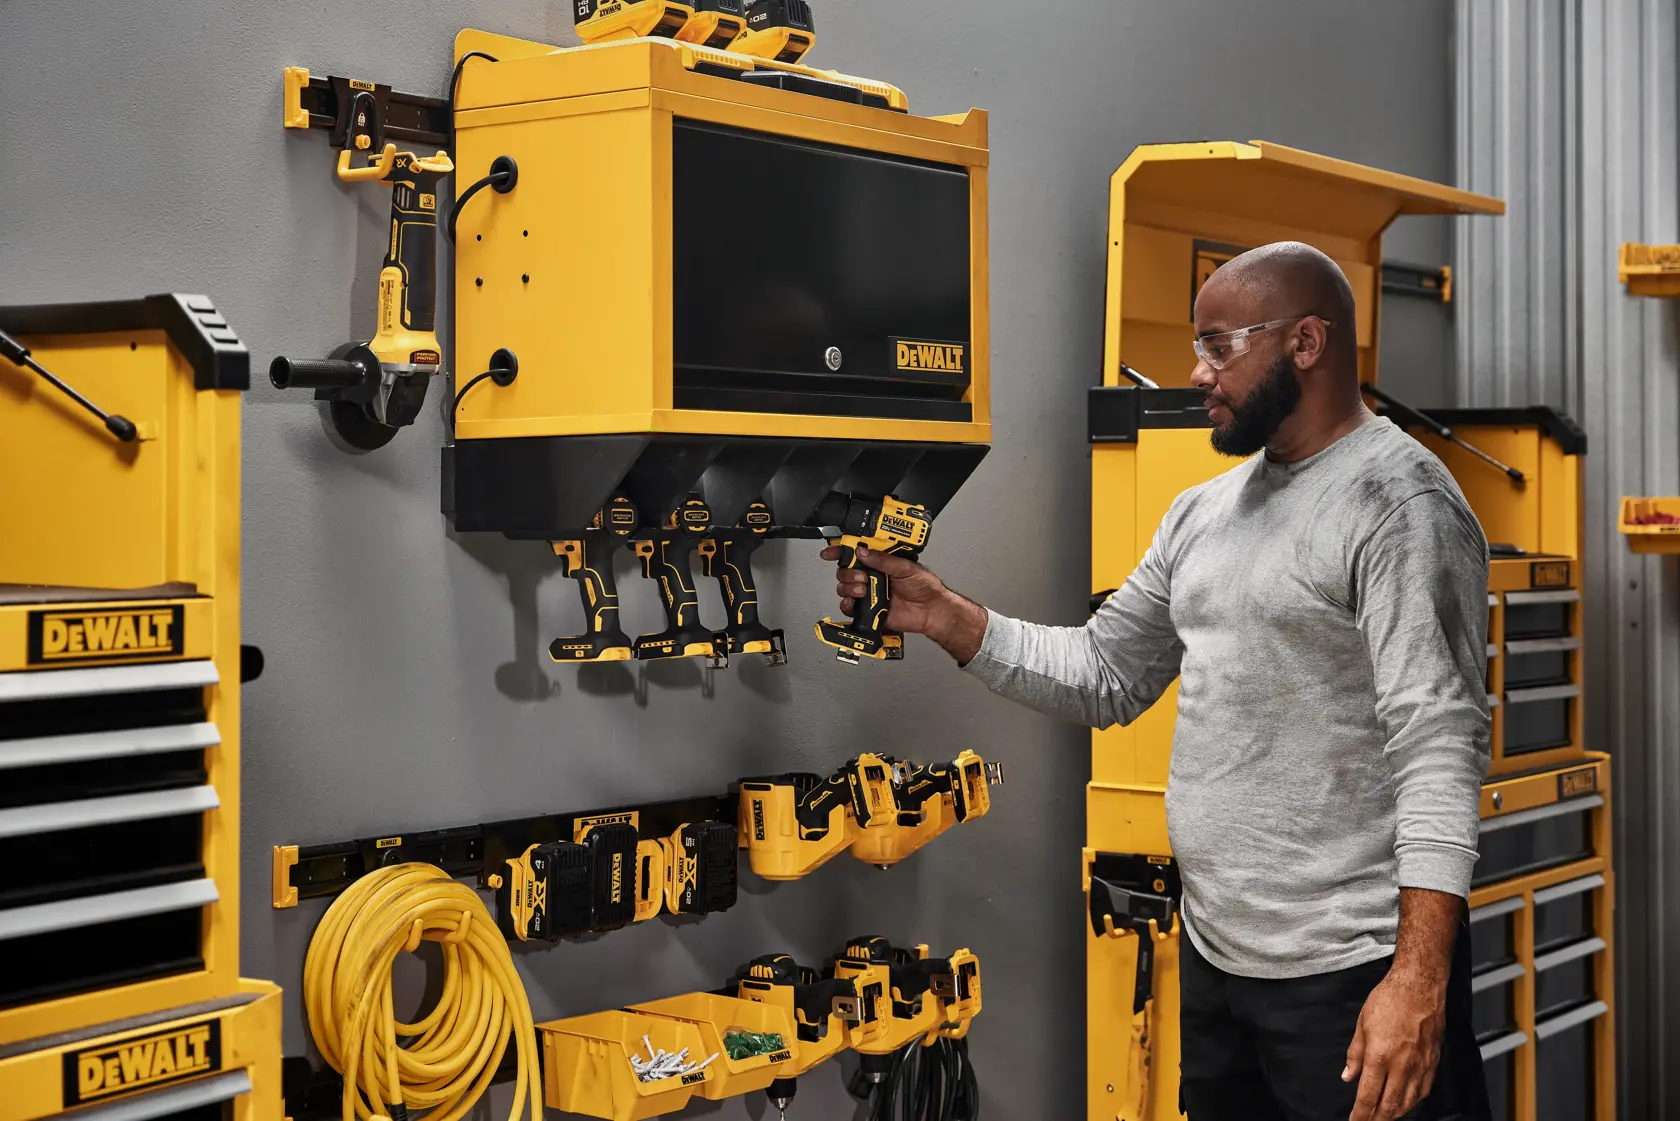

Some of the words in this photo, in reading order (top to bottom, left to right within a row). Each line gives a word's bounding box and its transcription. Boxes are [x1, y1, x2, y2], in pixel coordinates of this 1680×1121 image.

[578, 6, 590, 16] 10
[897, 343, 964, 371] DEWALT
[882, 515, 916, 530] DEWALT
[42, 614, 173, 654] DEWALT
[685, 836, 692, 847] 5
[535, 859, 541, 870] 4
[612, 852, 621, 904] DEWALT
[78, 1030, 211, 1095] DEWALT
[680, 1071, 705, 1086] DEWALT
